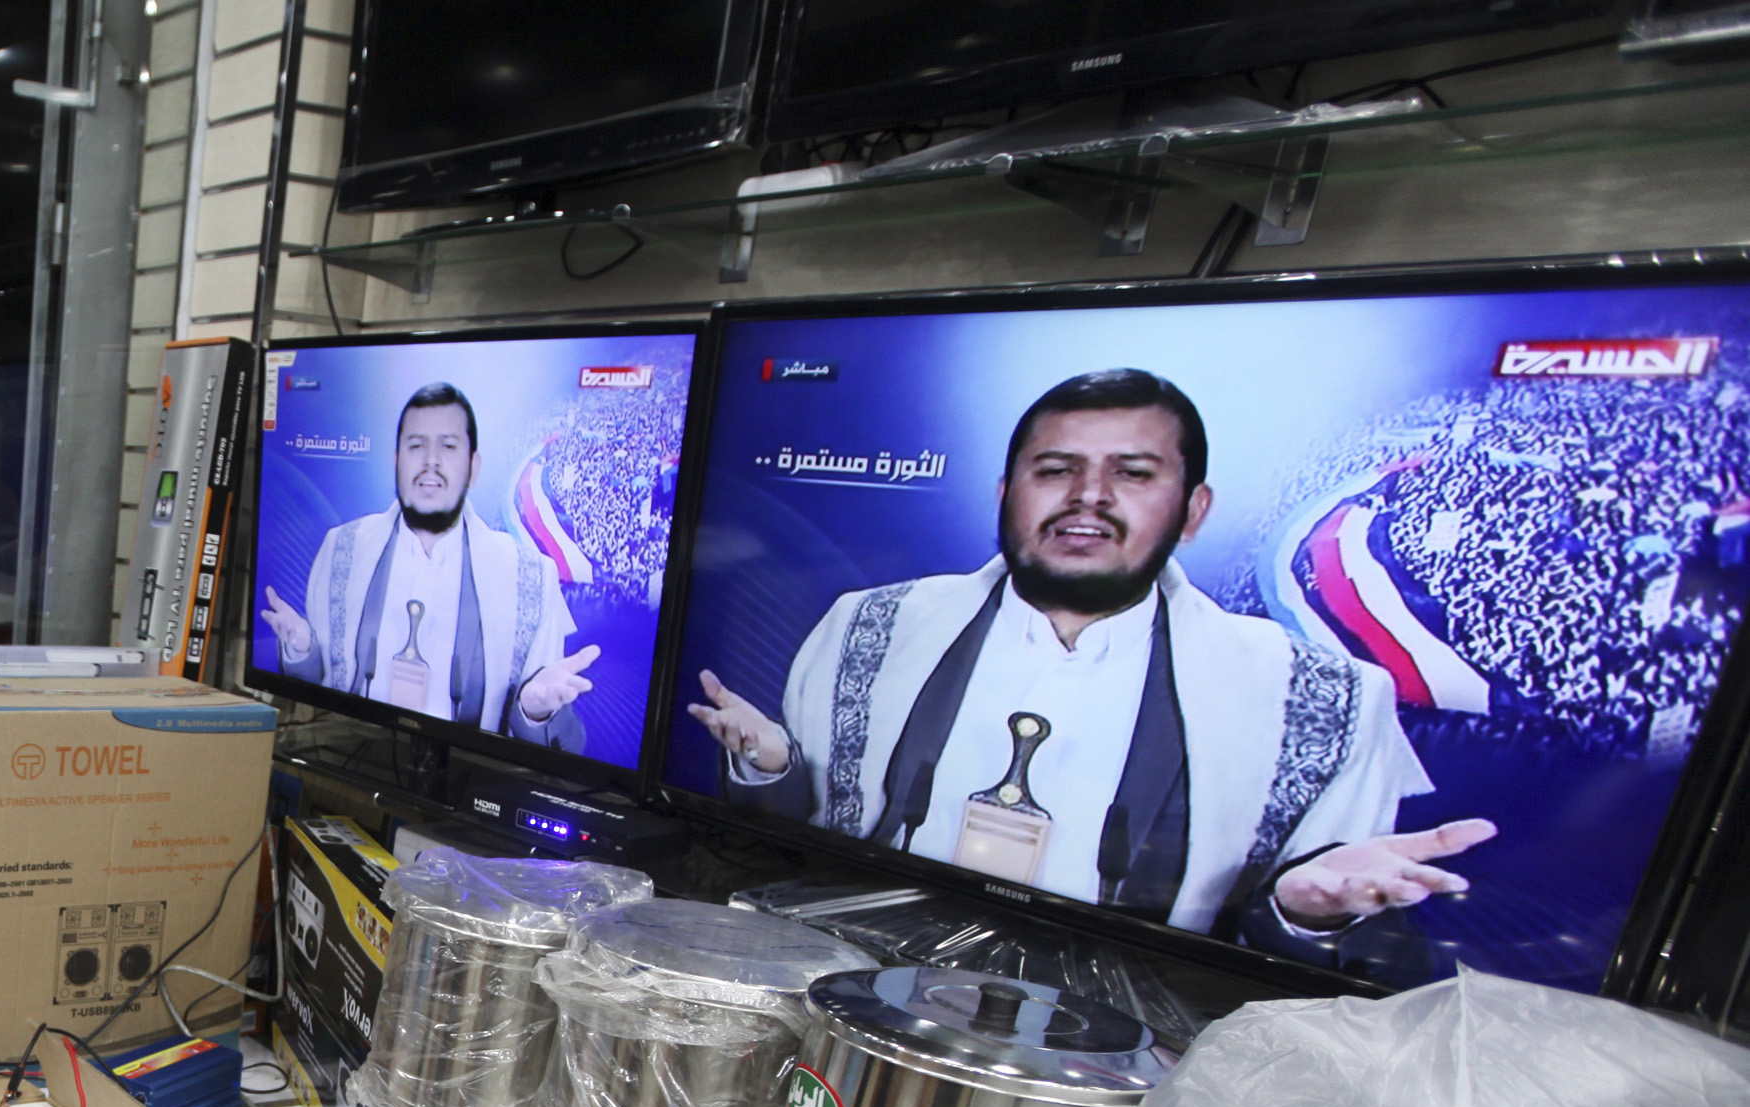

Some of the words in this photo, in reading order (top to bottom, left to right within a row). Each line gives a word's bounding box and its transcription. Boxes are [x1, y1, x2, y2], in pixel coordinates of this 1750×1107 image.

[1070, 52, 1123, 72] SAMSUNG
[781, 361, 830, 377] مباشر
[195, 374, 218, 462] Soporte
[296, 433, 337, 452] مستمرة
[340, 433, 371, 454] الثورة
[777, 447, 869, 475] مستمرة
[874, 449, 946, 483] الثورة
[184, 465, 201, 528] mural
[173, 532, 191, 581] para
[169, 585, 184, 617] TV
[162, 620, 178, 663] LCD
[156, 719, 172, 728] 2.0
[177, 719, 233, 728] Multimedia
[235, 719, 263, 728] audio
[55, 745, 150, 777] TOWEL
[49, 795, 85, 806] ACTIVE
[87, 793, 132, 805] SPEAKER
[136, 792, 171, 803] SERIES
[474, 797, 501, 812] HDMI
[132, 839, 158, 849] More
[160, 836, 210, 847] Wonderful
[21, 860, 73, 872] standards:
[985, 883, 1031, 903] SAMSUNG
